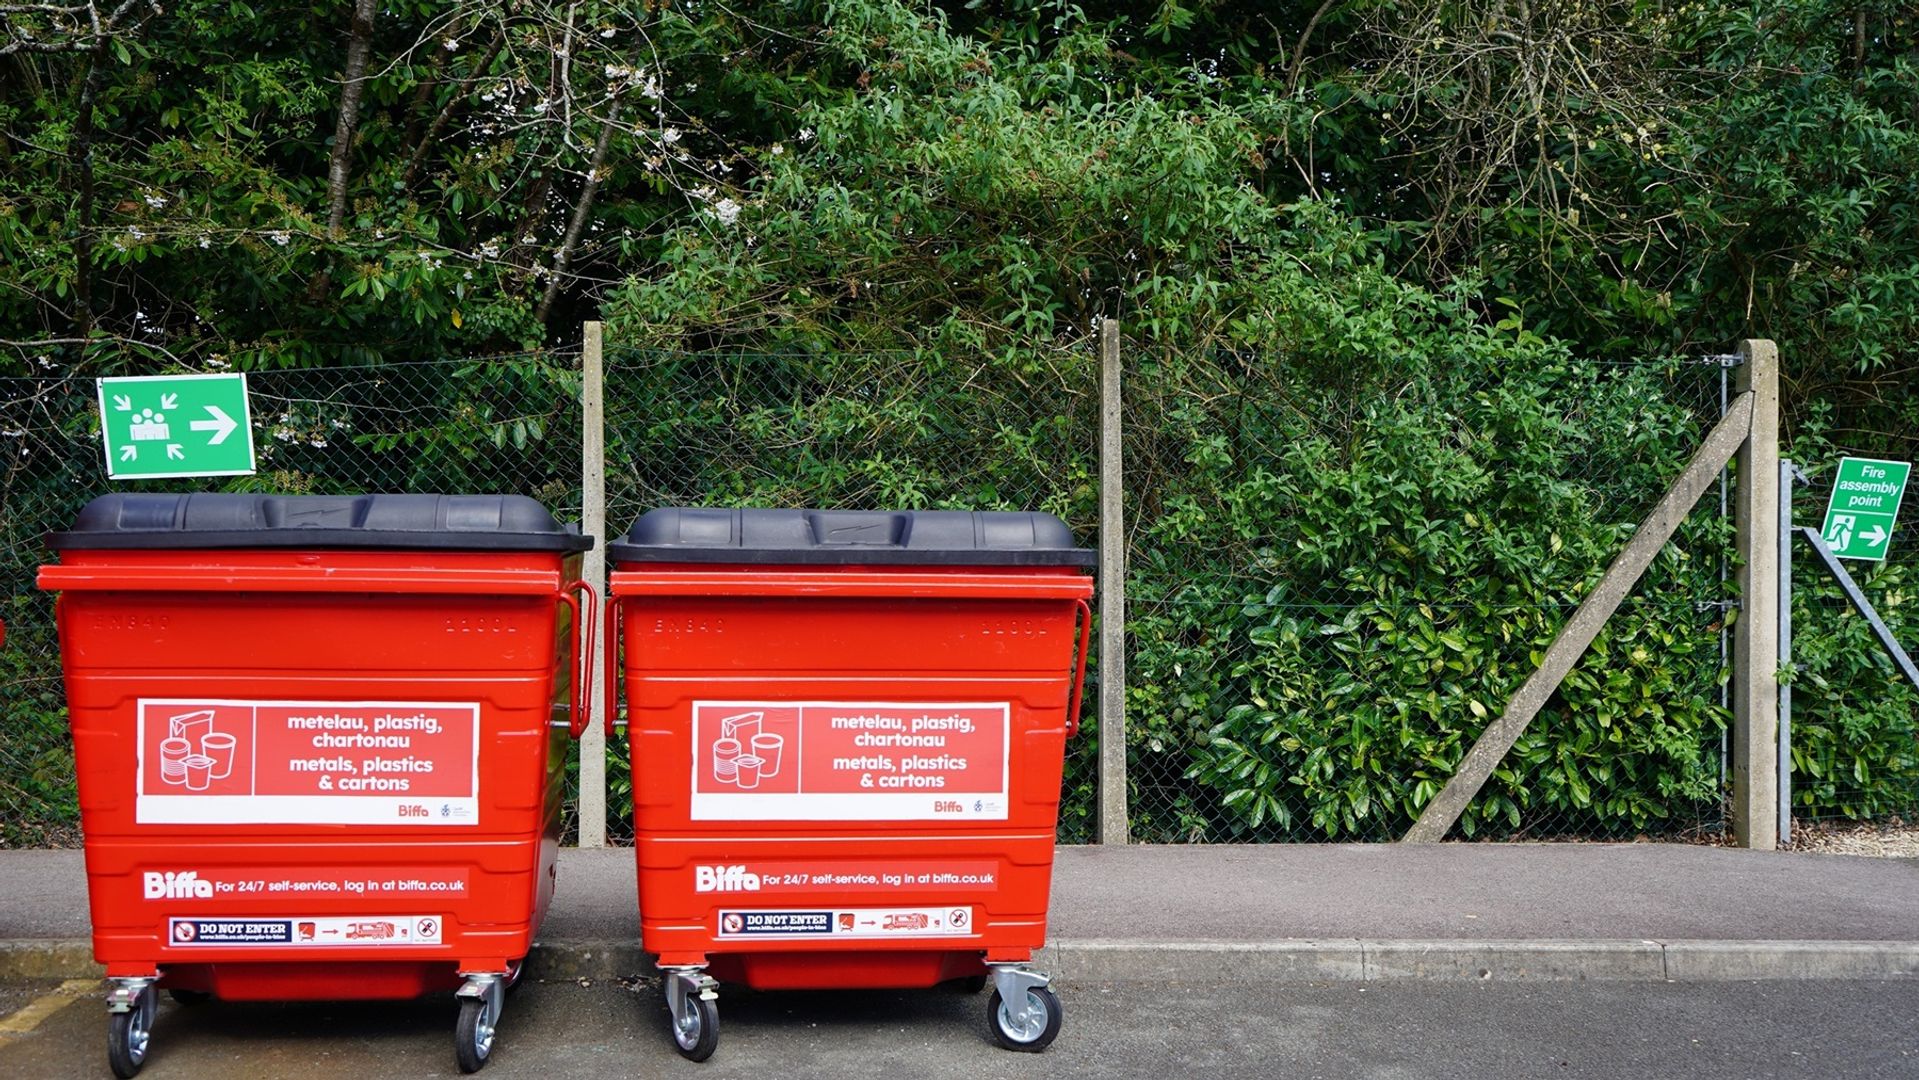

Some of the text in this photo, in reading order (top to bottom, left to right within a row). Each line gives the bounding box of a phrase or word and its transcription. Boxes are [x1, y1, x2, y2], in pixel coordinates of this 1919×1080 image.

[1861, 465, 1886, 478] Fire
[1839, 480, 1900, 496] assembly
[1848, 494, 1883, 507] point
[287, 714, 443, 734] metelau, plastig,
[831, 714, 976, 733] metelau, plastig,
[312, 732, 410, 748] chartonau
[854, 732, 945, 747] chartonau
[289, 756, 434, 775] metals, plastics
[833, 754, 967, 773] metals, plastics
[318, 774, 410, 790] & cartons
[860, 773, 945, 788] & cartons
[398, 804, 429, 817] Biffa
[934, 801, 963, 813] Biffa
[143, 871, 464, 899] Biffa For 24/7 self-service, log in at biffa.co.uk
[696, 865, 994, 892] Biffa For 24/7 self-service, log in at biffa.co.uk
[747, 914, 827, 925] DO NOT ENTER
[200, 924, 286, 933] DO NOT ENTER
